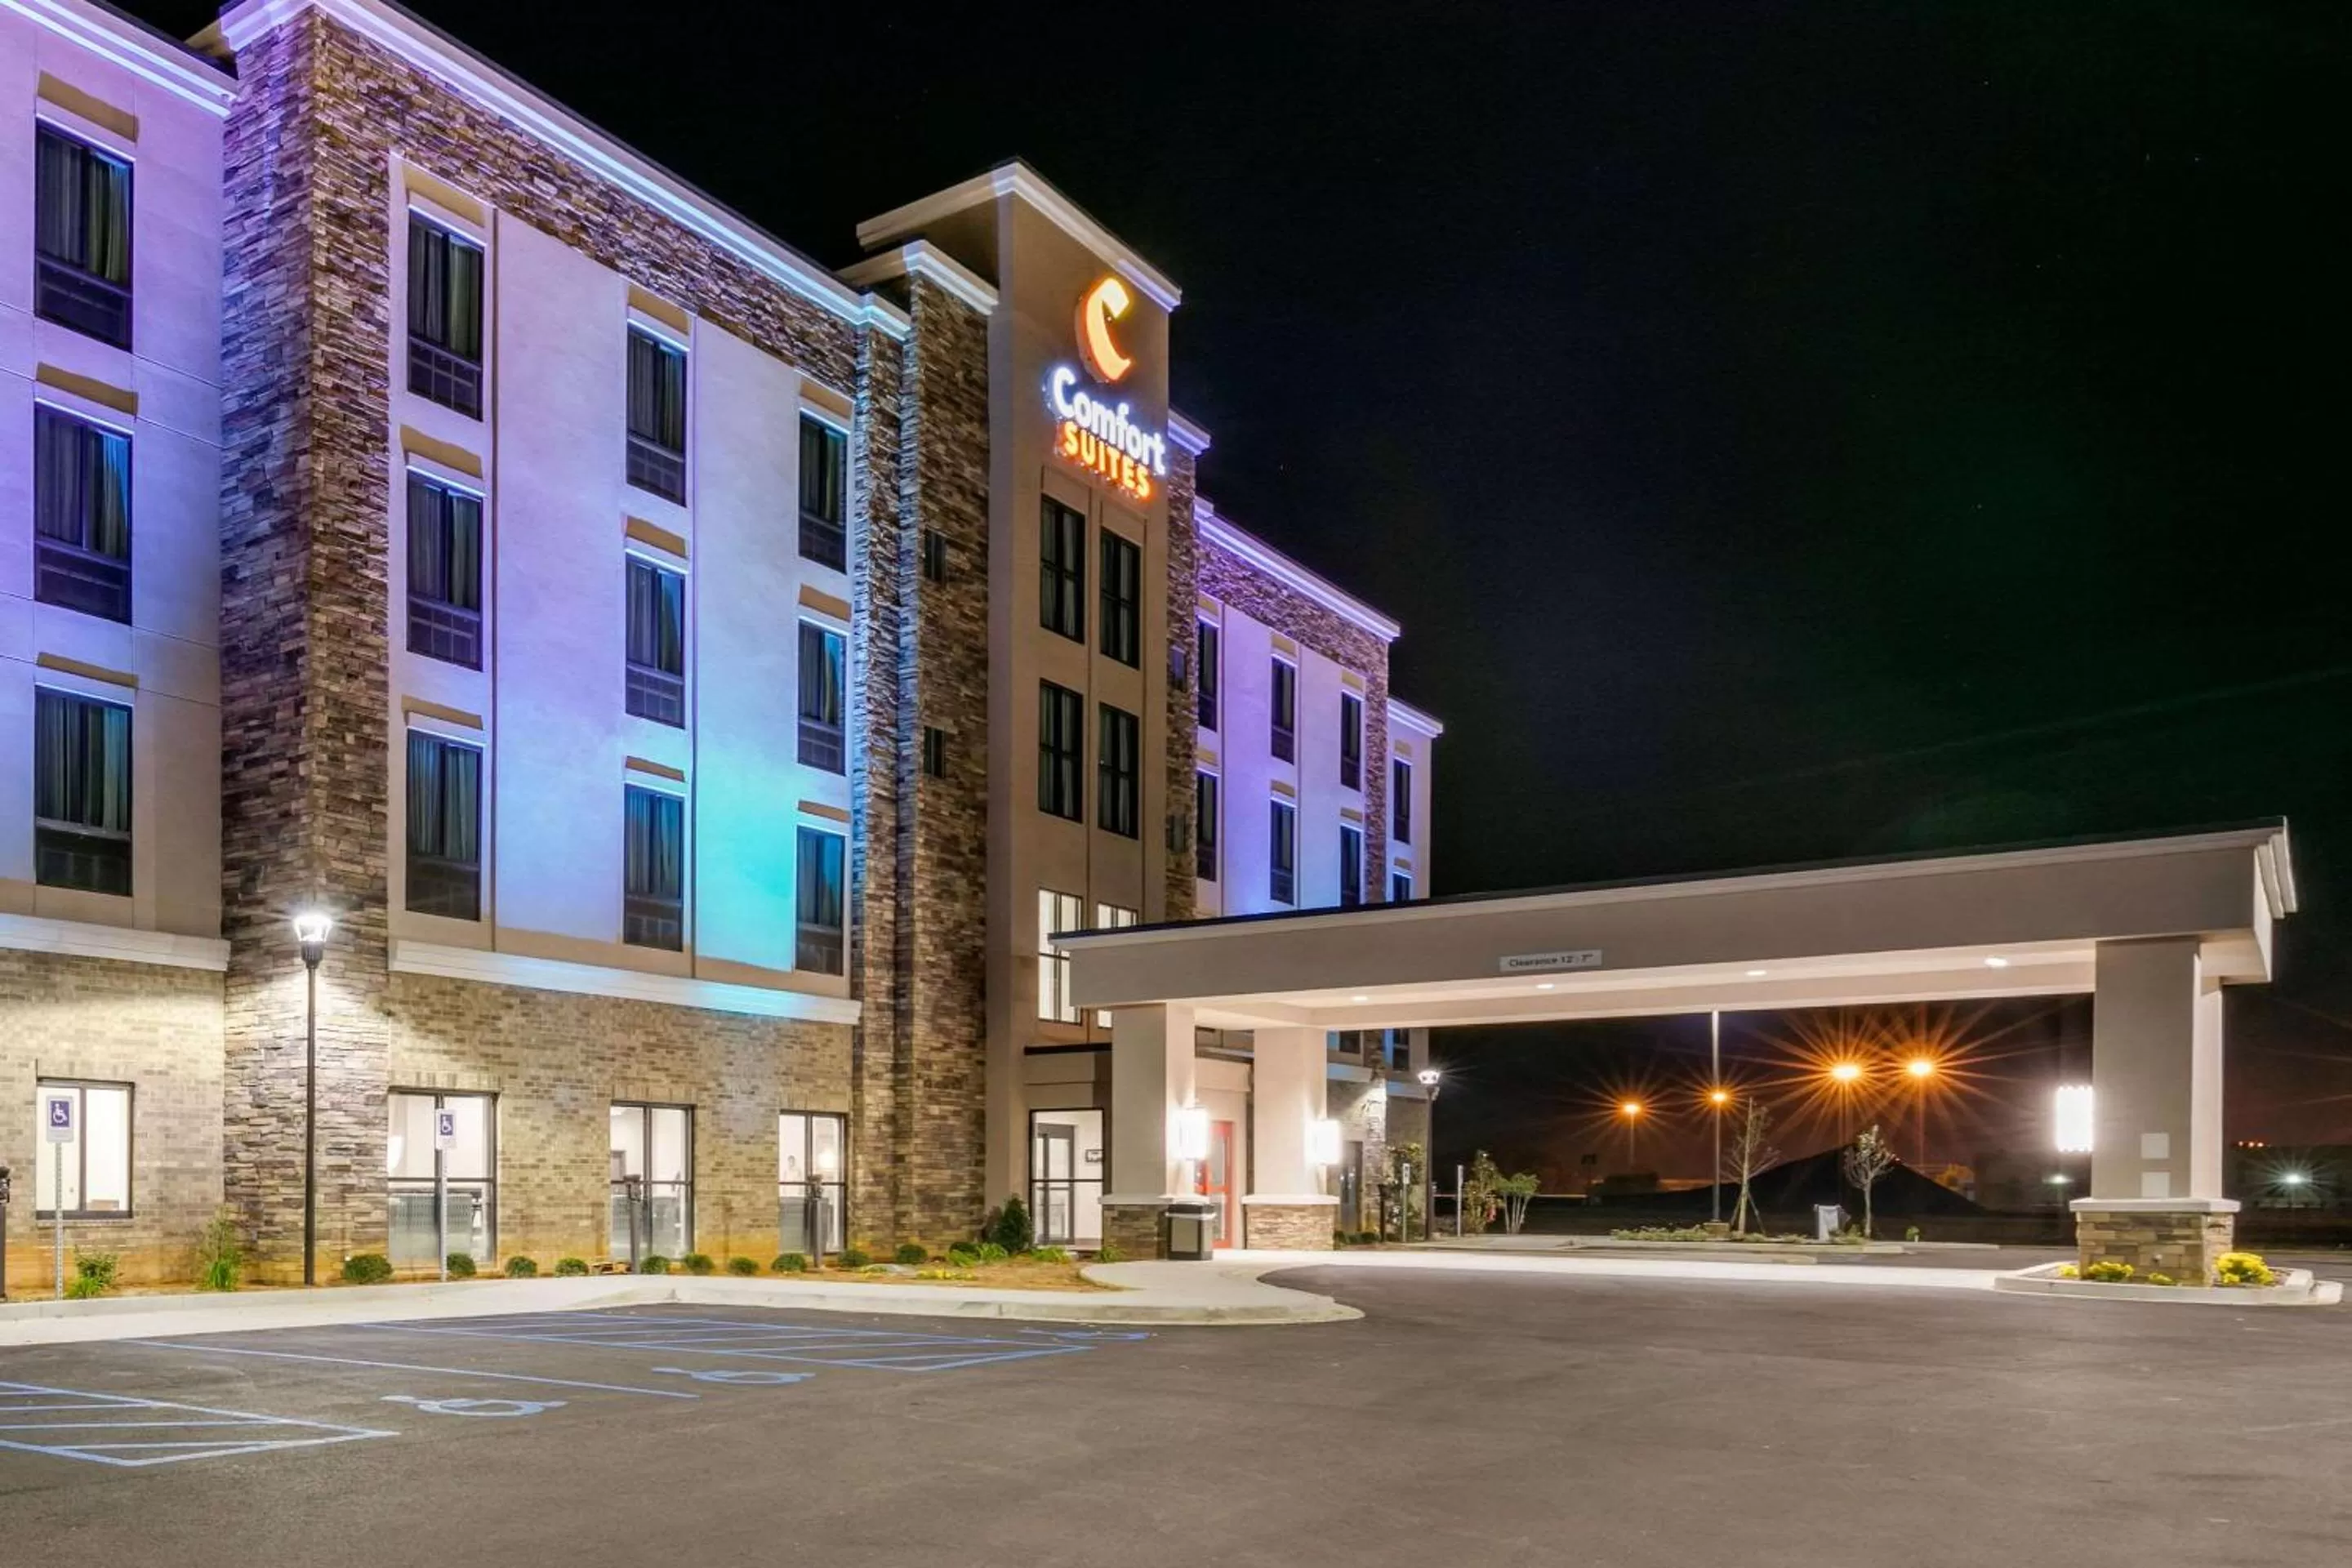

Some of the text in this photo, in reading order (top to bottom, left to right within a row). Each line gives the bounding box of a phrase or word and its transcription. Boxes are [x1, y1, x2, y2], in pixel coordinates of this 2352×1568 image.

[1052, 367, 1165, 475] Comfort
[1064, 421, 1150, 497] SUITES
[1509, 956, 1558, 968] Clearance
